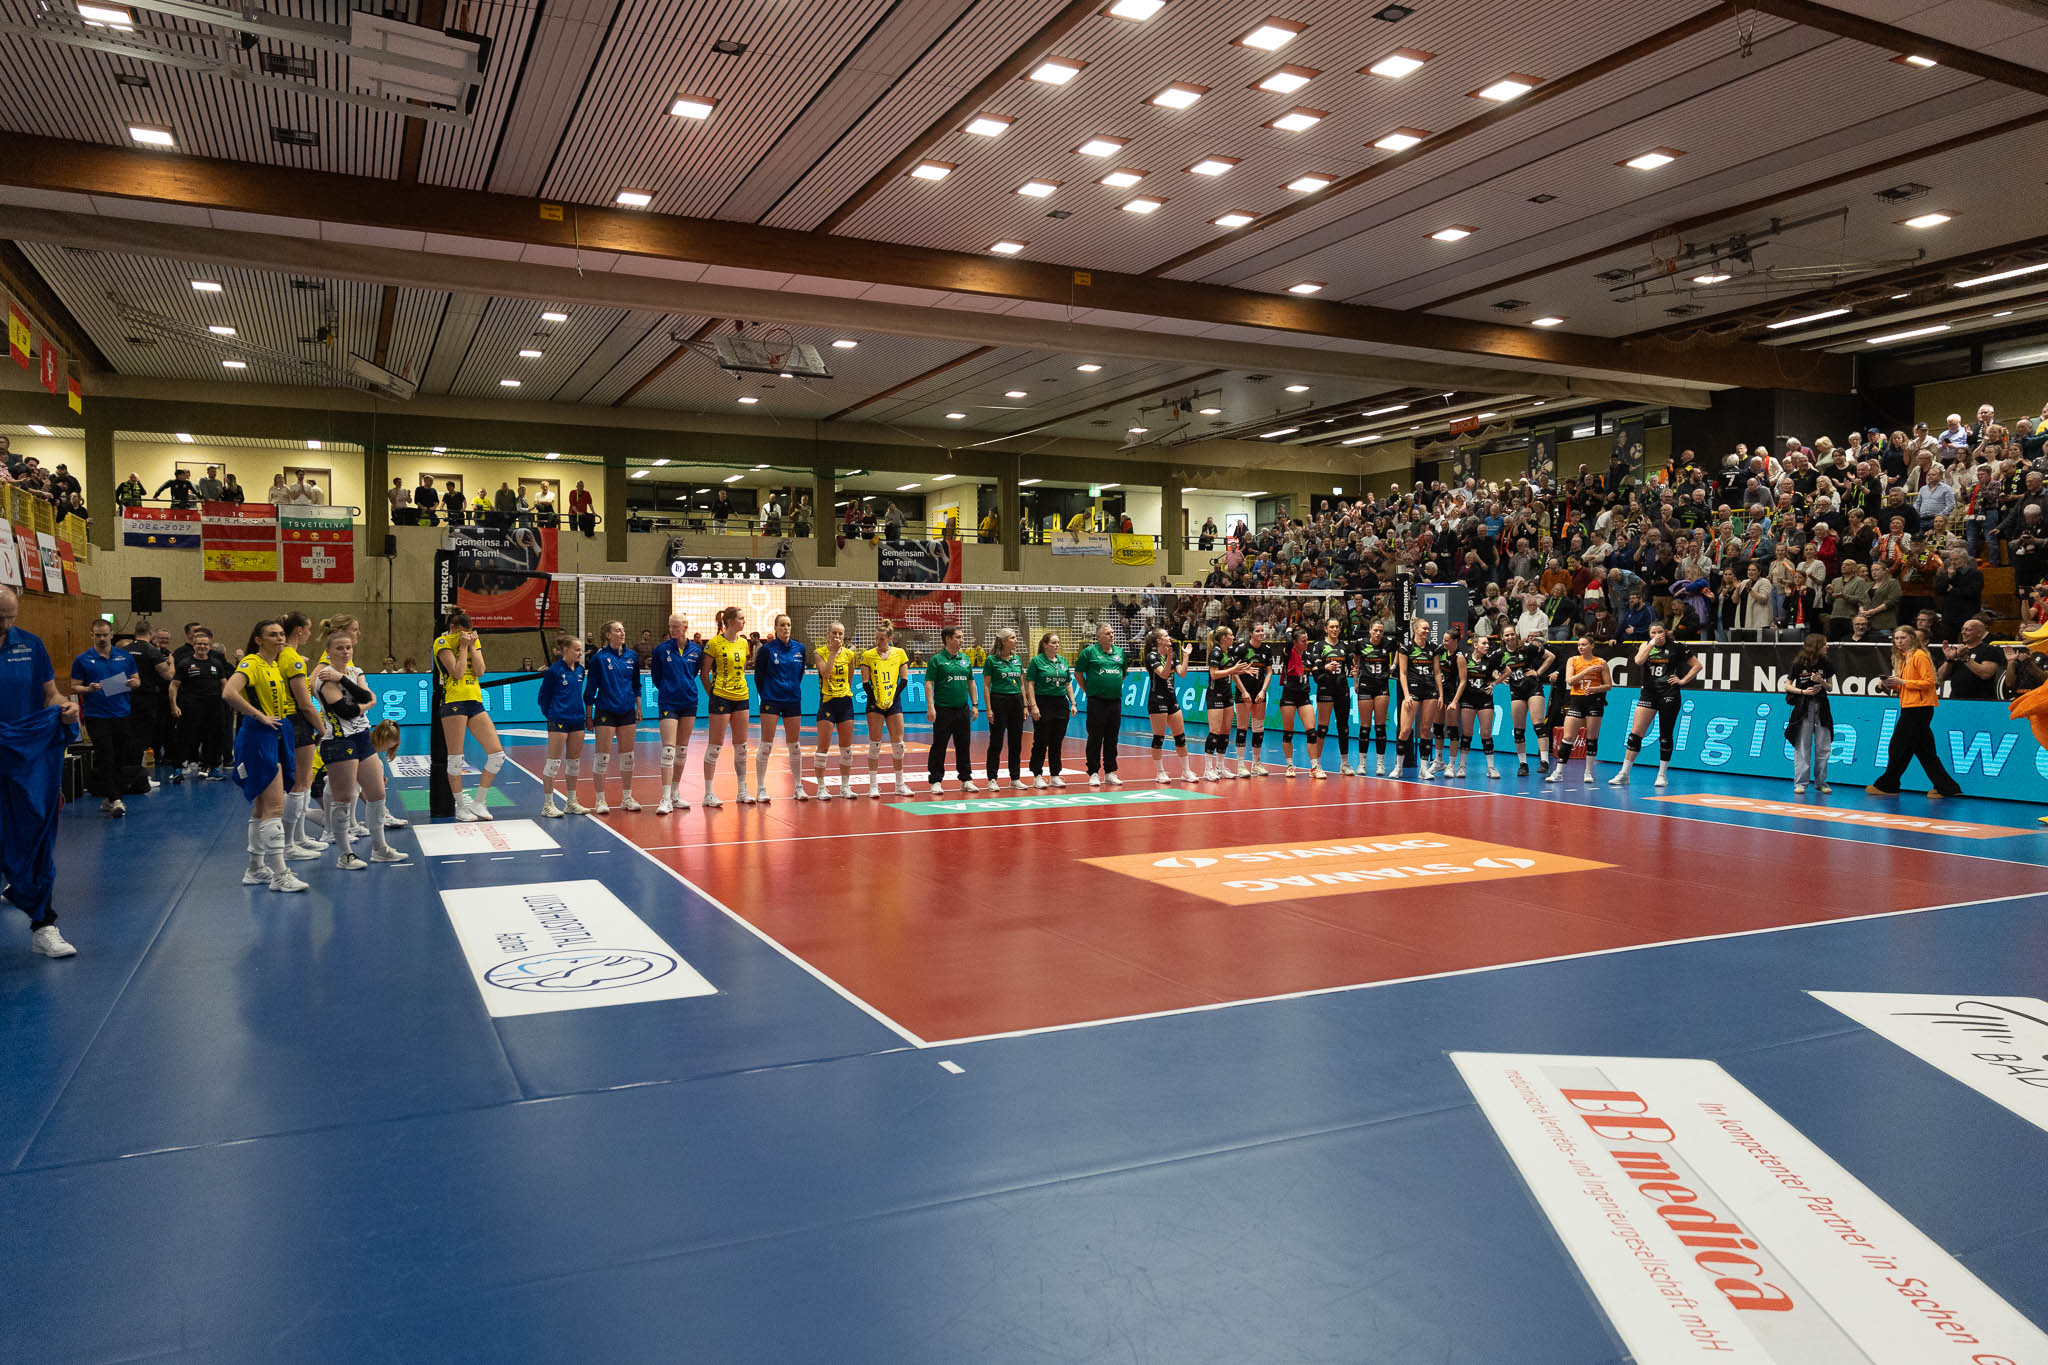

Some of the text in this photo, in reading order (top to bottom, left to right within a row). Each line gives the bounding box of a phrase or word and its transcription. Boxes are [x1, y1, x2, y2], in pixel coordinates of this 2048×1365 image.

[1726, 474, 1736, 486] 7
[472, 548, 500, 558] Team!
[882, 548, 925, 557] Gemeinsam
[686, 562, 699, 572] 25
[714, 562, 723, 572] 3
[738, 562, 746, 572] 1
[755, 562, 766, 572] 18
[882, 558, 918, 566] ein Team!
[441, 560, 450, 602] DIRKRA
[1426, 598, 1438, 608] n
[834, 664, 844, 674] 12
[882, 672, 890, 680] 11
[1370, 664, 1382, 674] 13
[1417, 666, 1430, 675] 16
[1650, 666, 1664, 677] 18
[926, 795, 1112, 811] DEKRA
[1753, 804, 1982, 833] STAWAG
[1224, 839, 1450, 864] STAWAG
[1221, 862, 1475, 892] STAWAG
[522, 894, 597, 948] LUISENHOSPITAL
[496, 932, 534, 954] Aachen
[1504, 1068, 1549, 1114] medizinische
[1568, 1160, 1605, 1177] und
[1608, 1150, 1794, 1312] medica
[1696, 1101, 1727, 1116] Ihr
[1716, 1119, 1812, 1192] kompetenter
[1798, 1194, 1876, 1250] Partner
[1862, 1254, 1898, 1270] in
[1885, 1276, 1981, 1345] Sachen
[1582, 1180, 1699, 1310] Ingenieurgesellschaft
[1680, 1314, 1735, 1352] mbH
